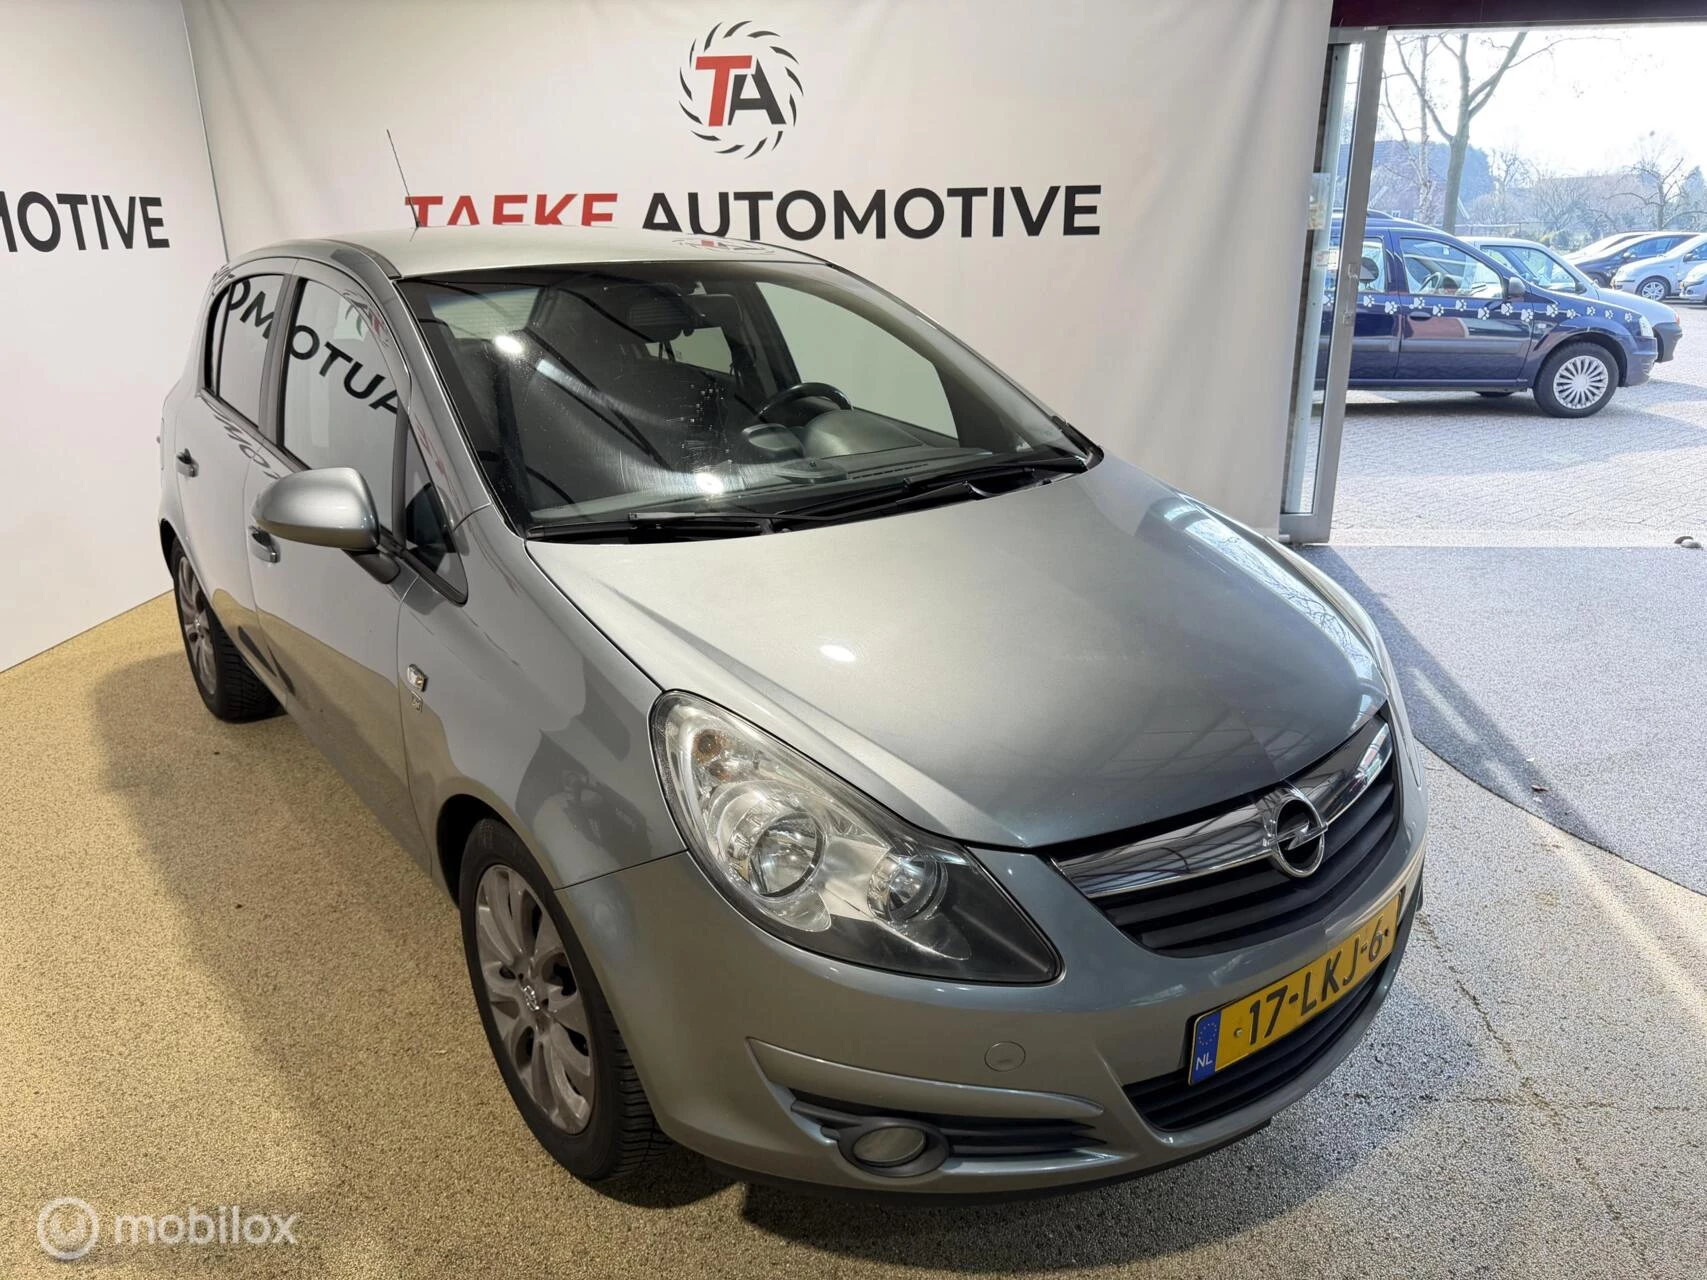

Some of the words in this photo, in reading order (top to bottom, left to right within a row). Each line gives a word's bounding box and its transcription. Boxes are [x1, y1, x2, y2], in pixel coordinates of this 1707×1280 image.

[695, 55, 787, 127] TA
[642, 185, 1101, 240] AUTOMOTIVE
[1249, 917, 1384, 1046] 17-LKJ-6
[1196, 1053, 1214, 1071] NL
